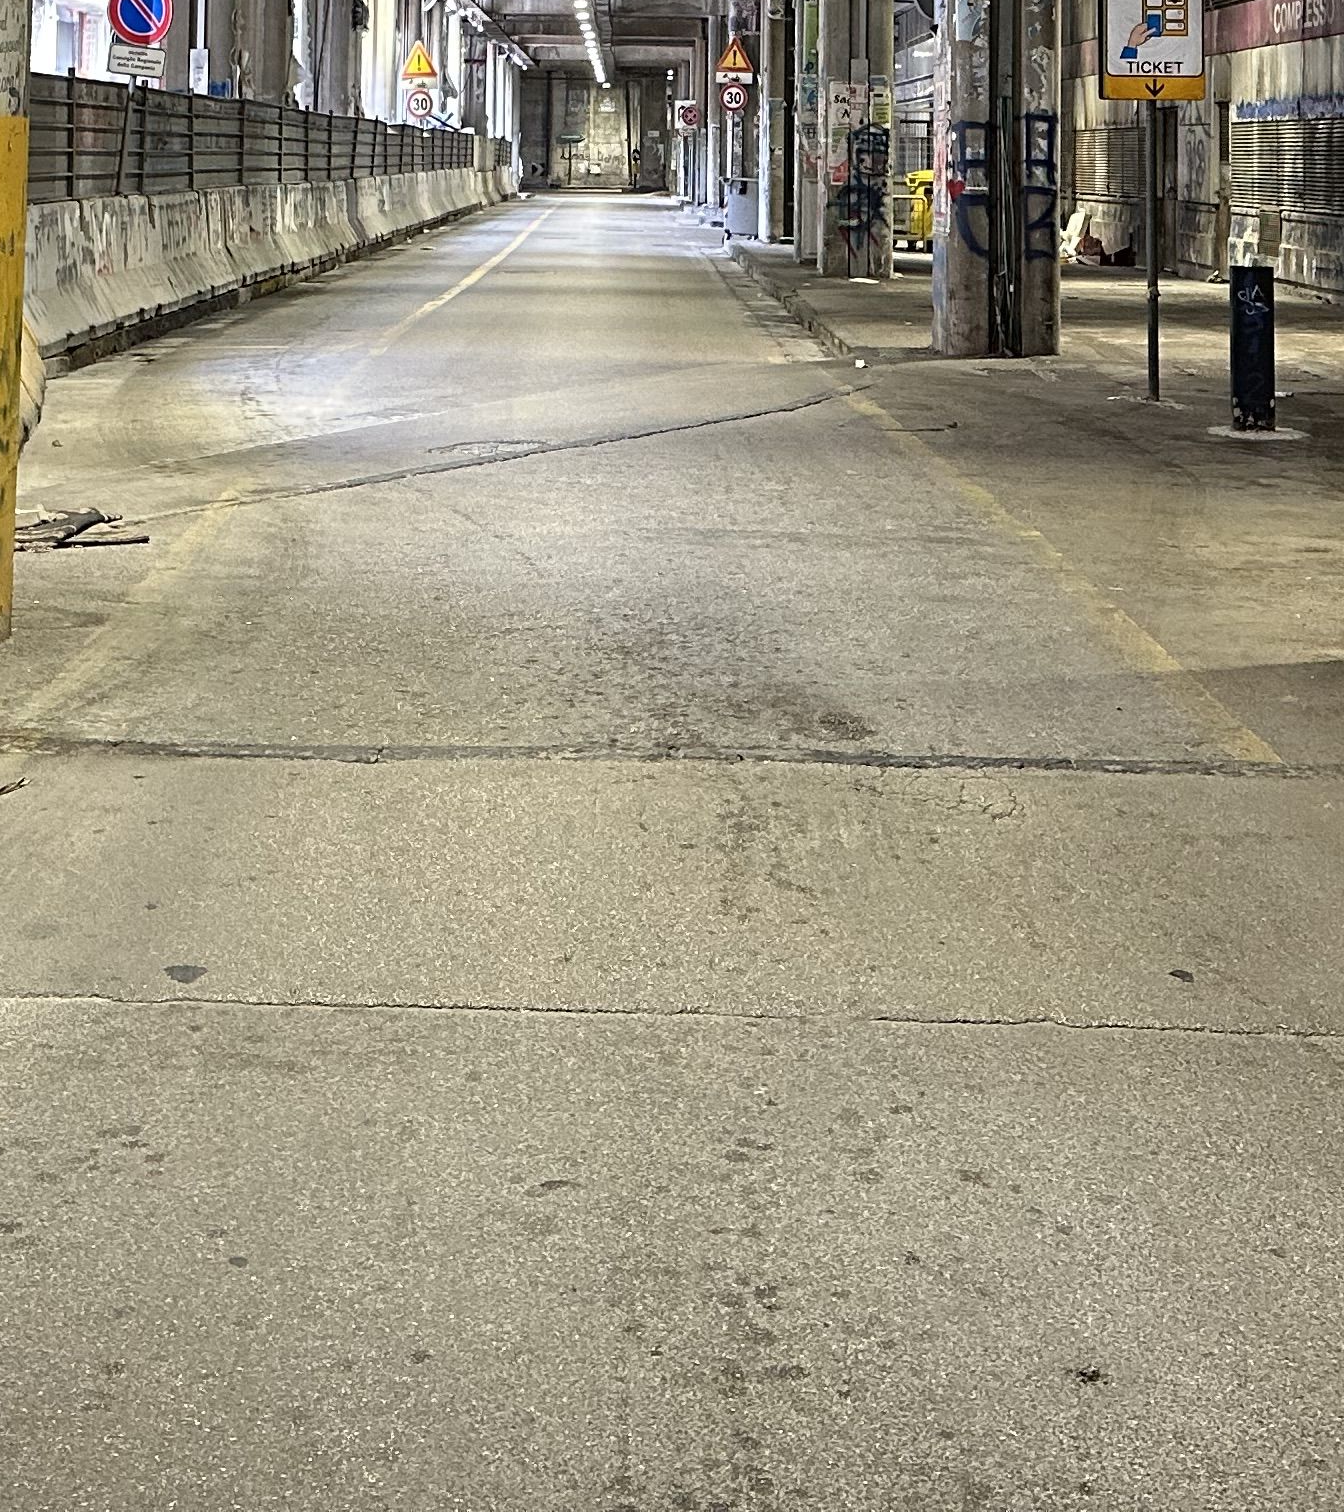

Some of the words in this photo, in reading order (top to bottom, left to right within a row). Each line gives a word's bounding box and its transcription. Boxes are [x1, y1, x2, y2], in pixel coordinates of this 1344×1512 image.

[1127, 61, 1184, 74] TICKET
[413, 97, 428, 111] 30
[726, 91, 742, 105] 30
